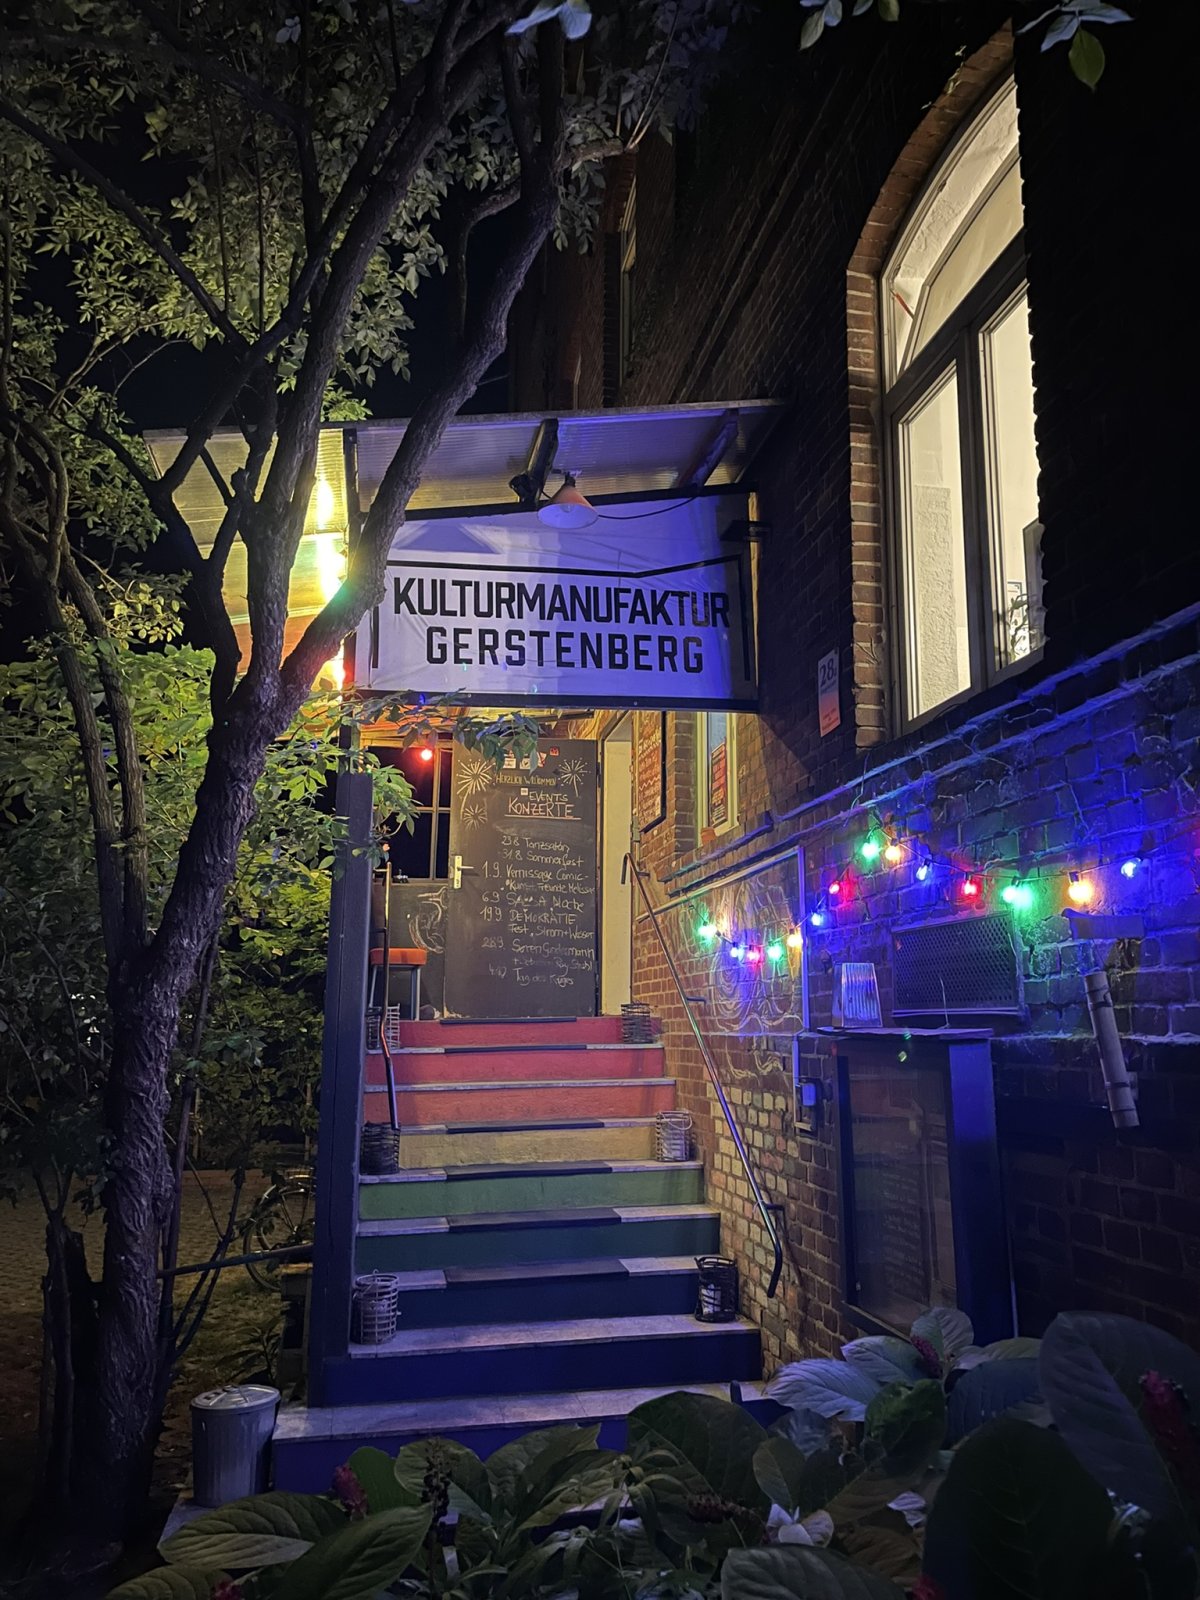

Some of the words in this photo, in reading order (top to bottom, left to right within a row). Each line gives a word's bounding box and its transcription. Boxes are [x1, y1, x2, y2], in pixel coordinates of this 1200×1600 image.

[394, 577, 730, 628] KULTURMANUFAKTUR
[426, 626, 704, 673] GERSTENBERG
[529, 790, 569, 802] EVENTS
[508, 796, 575, 818] KONZERTE
[506, 864, 553, 884] Vernissage
[509, 909, 577, 925] DEMOKRATIE
